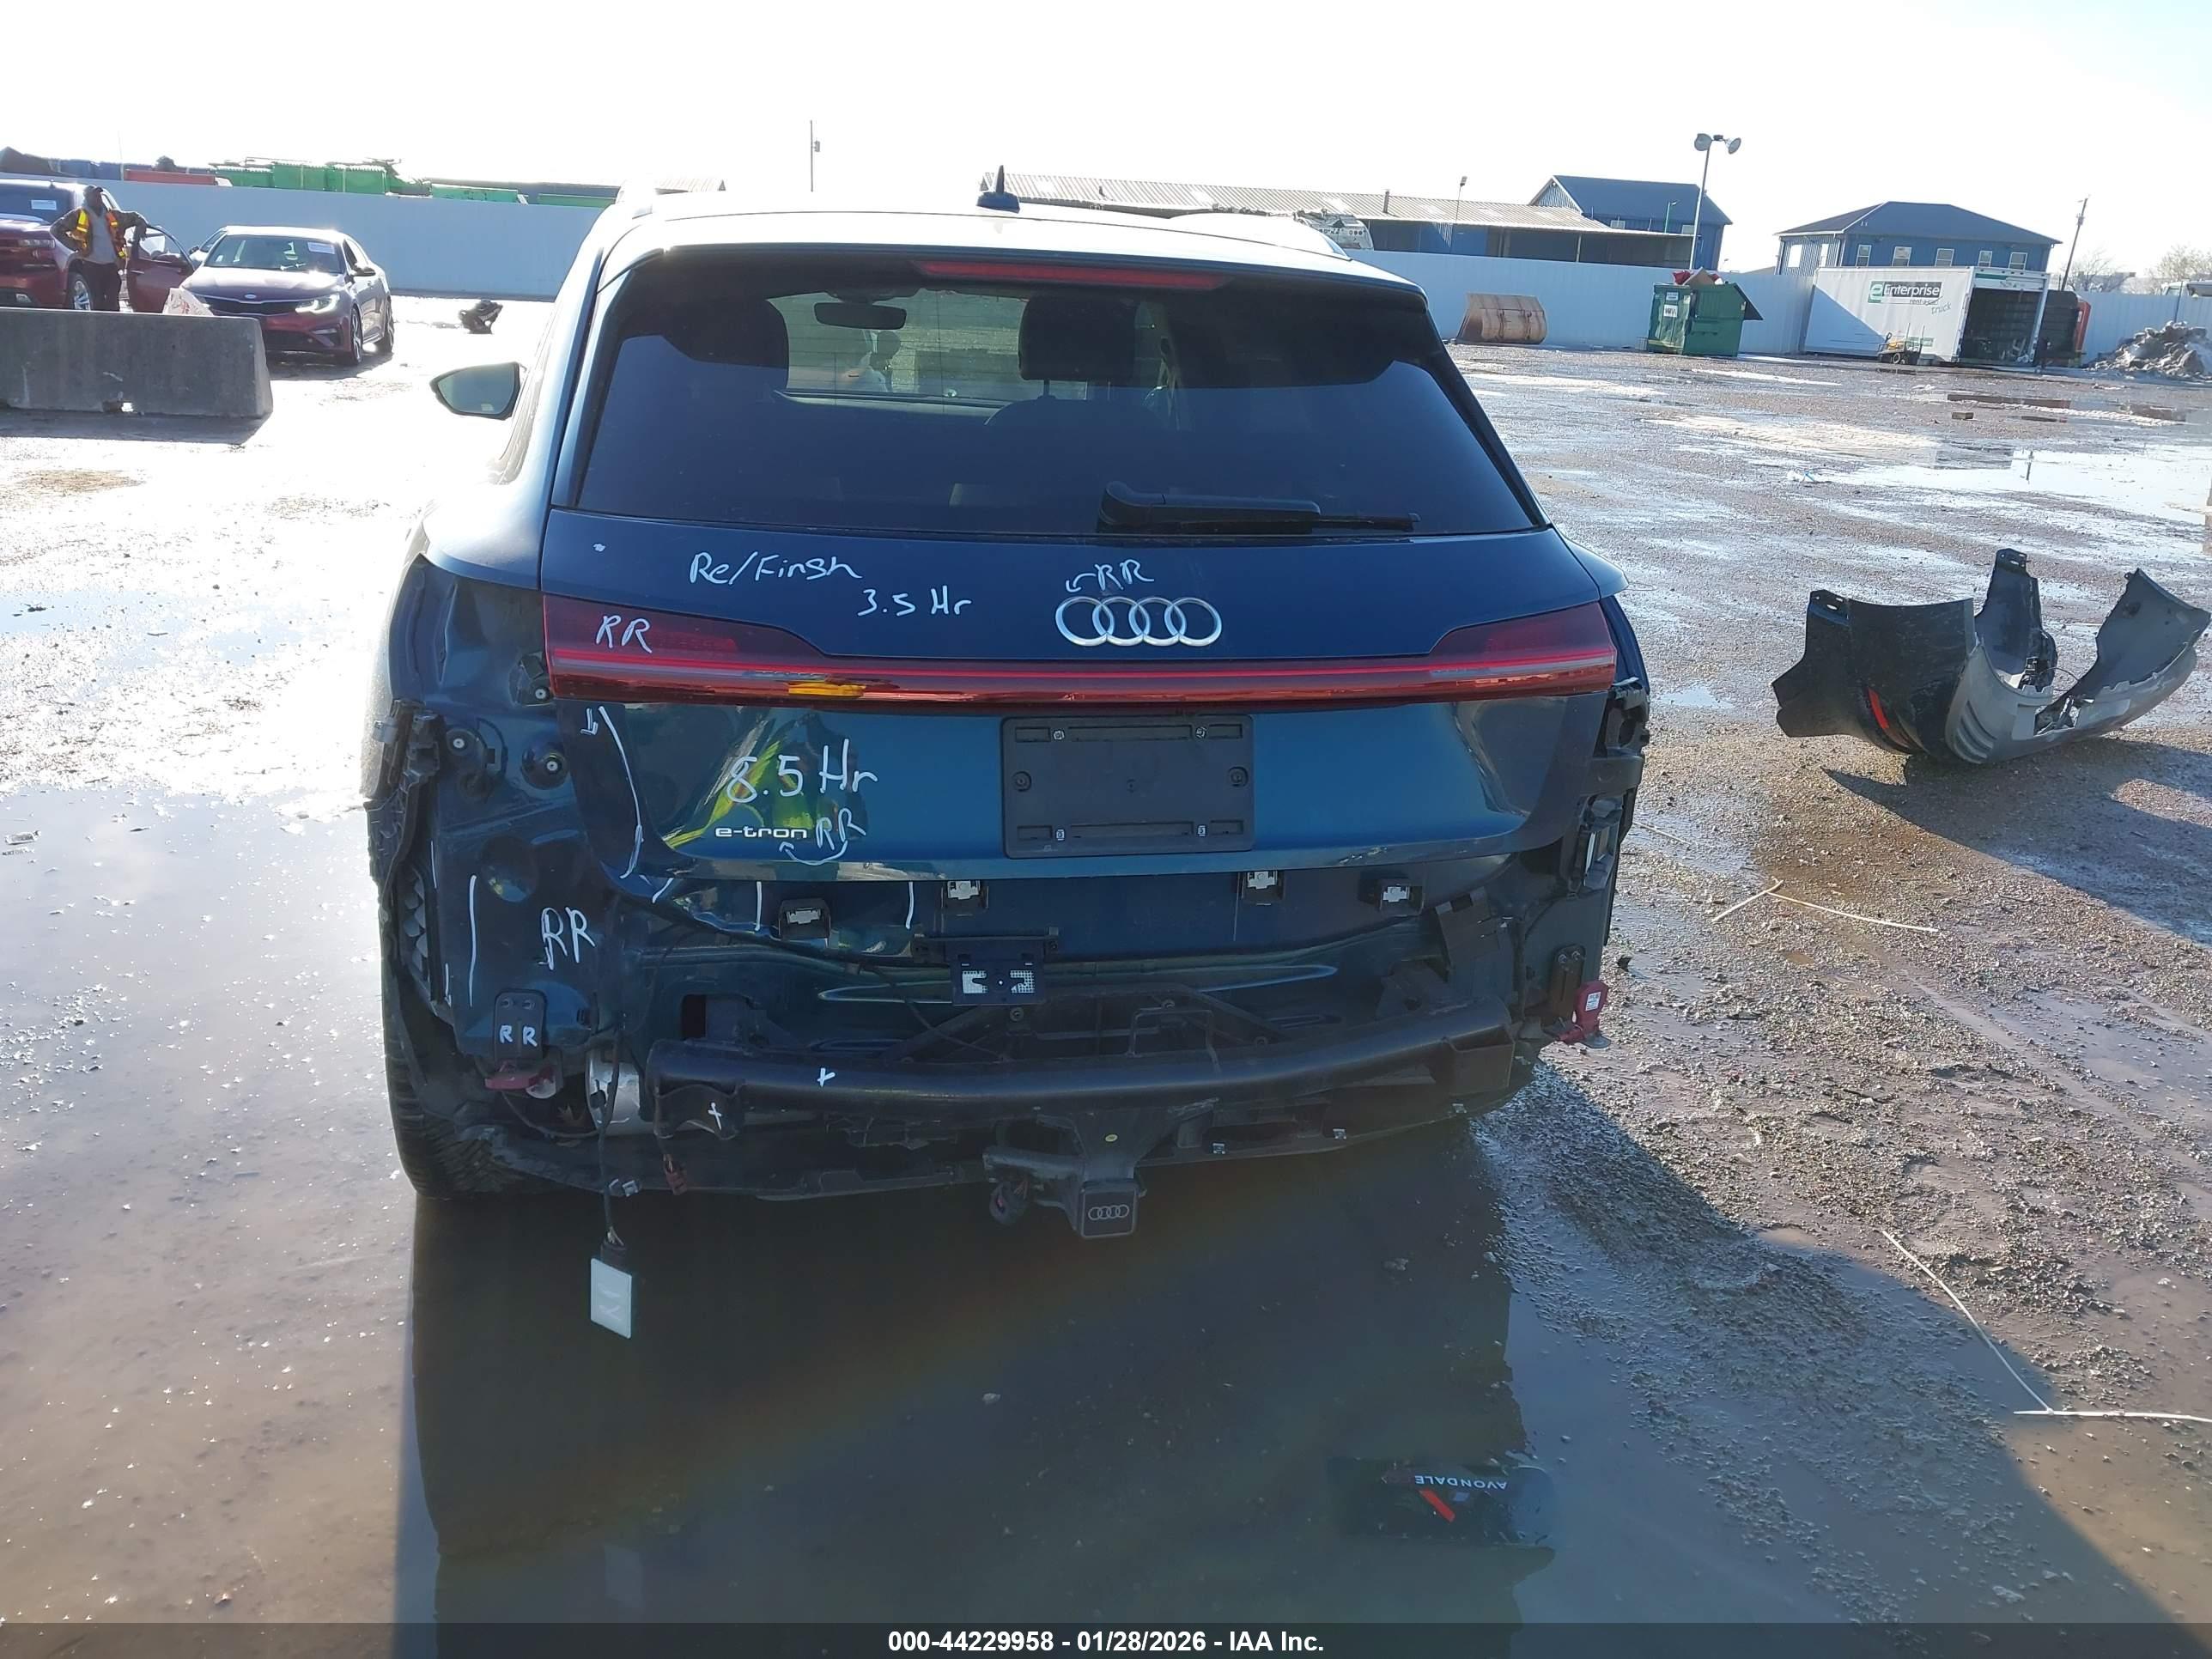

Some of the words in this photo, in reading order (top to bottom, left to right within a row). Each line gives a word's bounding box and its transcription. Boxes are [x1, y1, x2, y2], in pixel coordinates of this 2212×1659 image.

[1884, 283, 1940, 297] Enterprise
[1931, 302, 1952, 314] truck
[1095, 559, 1154, 590] RR
[858, 589, 916, 617] 3.5
[931, 586, 972, 615] Hr
[596, 615, 653, 653] RR
[726, 756, 804, 803] 8.5
[818, 738, 878, 793] Hr
[715, 826, 808, 838] e-tron
[816, 808, 866, 851] RR
[540, 907, 595, 970] RR
[1415, 1475, 1509, 1490] AVONDALE
